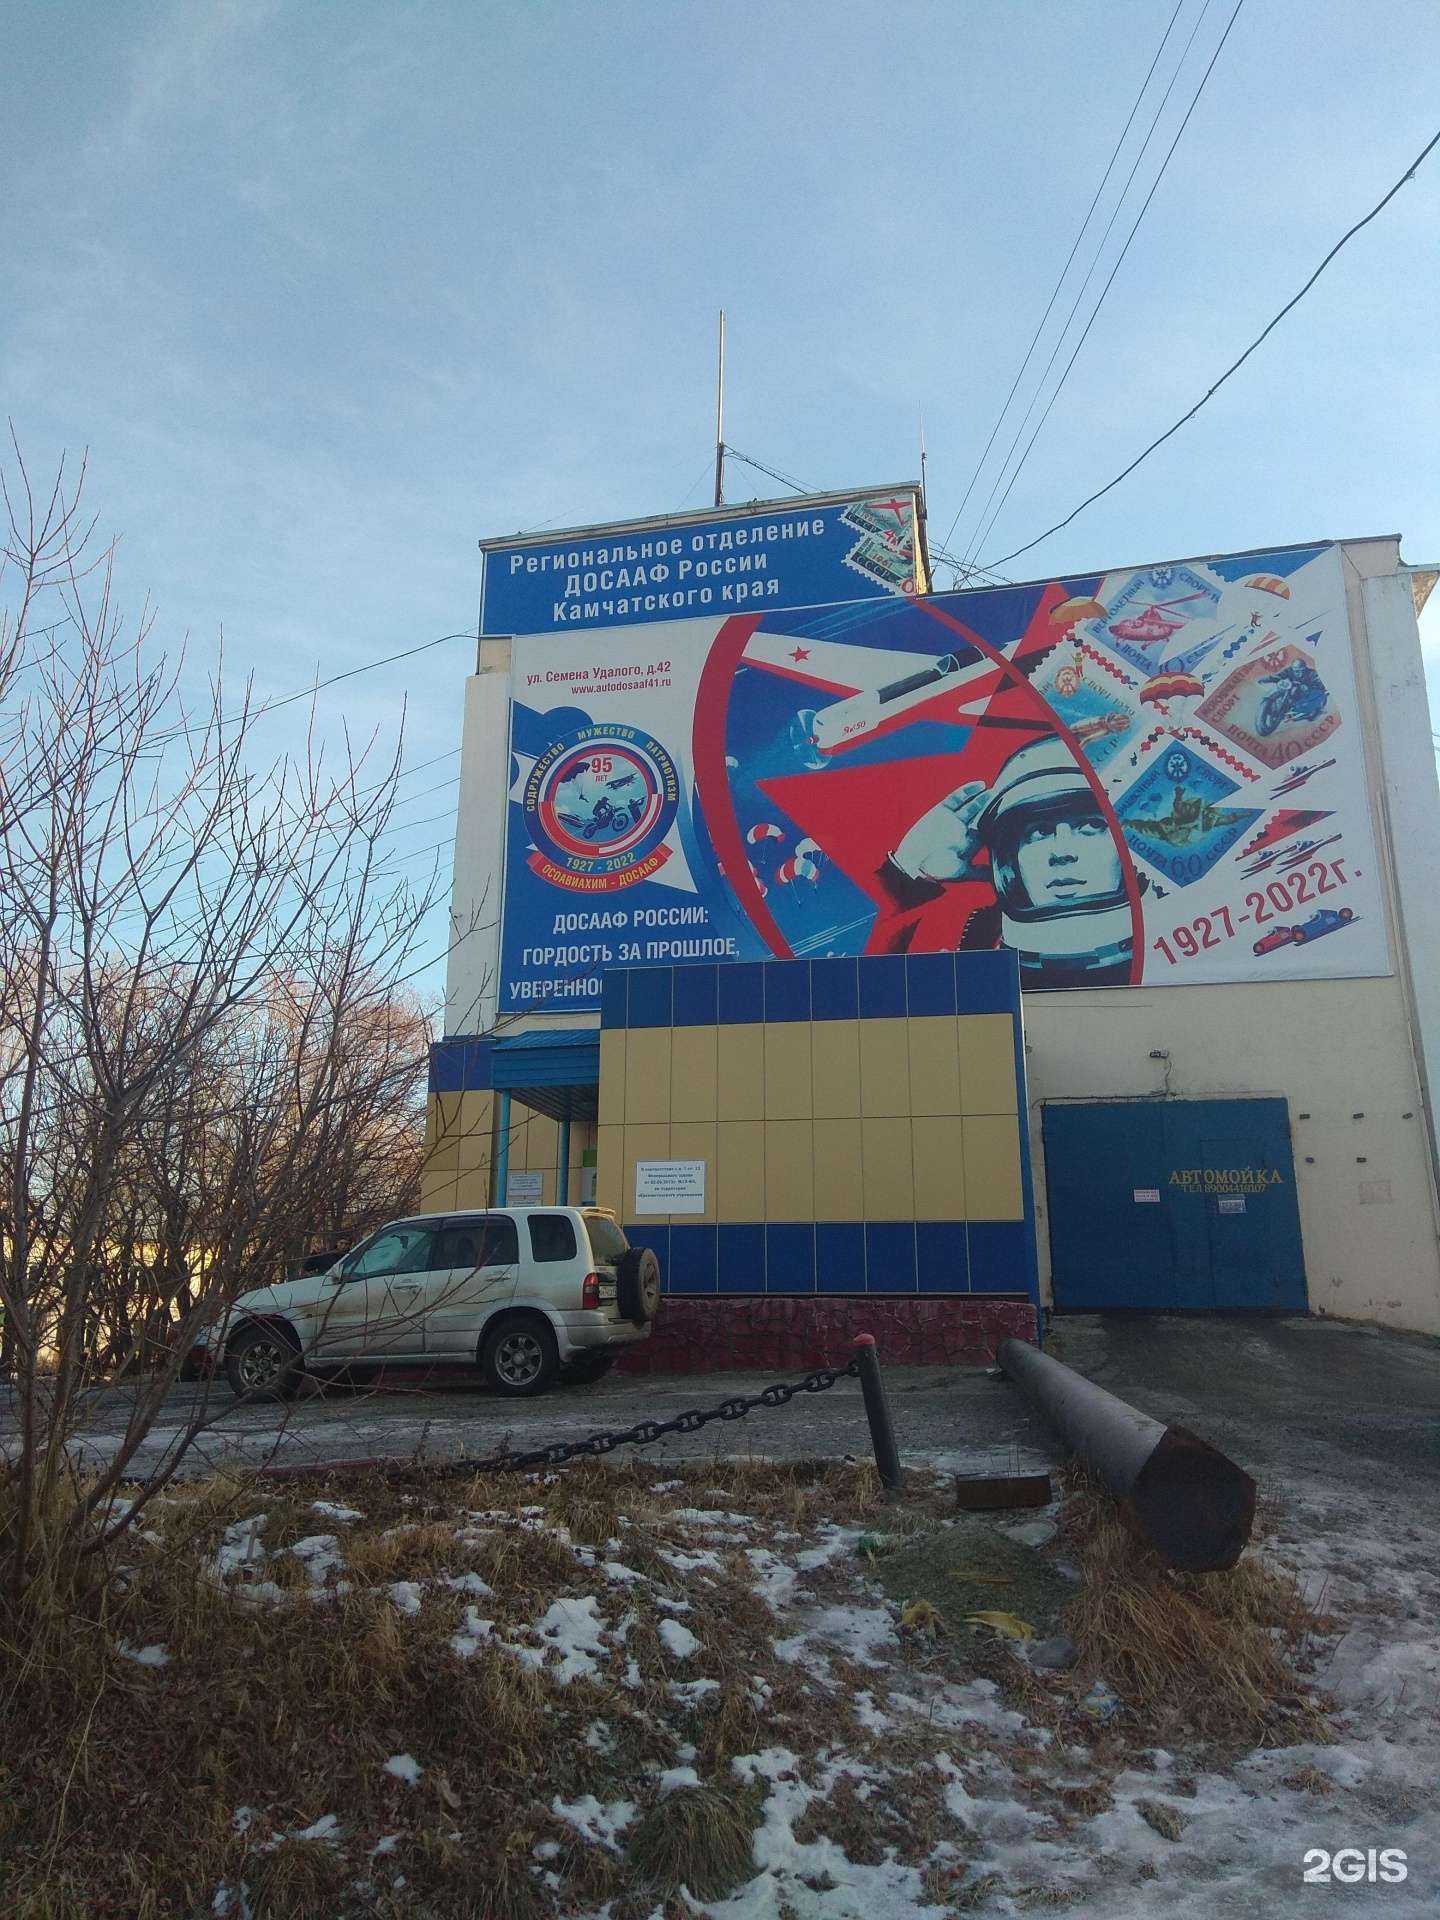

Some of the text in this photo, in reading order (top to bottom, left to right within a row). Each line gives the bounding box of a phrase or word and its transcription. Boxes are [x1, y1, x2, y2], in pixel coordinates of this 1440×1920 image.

[510, 539, 682, 575] Региональное
[691, 518, 825, 551] отделение
[564, 553, 768, 598] ДОСААФ России
[553, 580, 780, 622] Камчатского края
[527, 661, 671, 686] ул. Семена Удалого, д.42
[571, 678, 672, 695] www.autodosaaf41.ru
[577, 726, 635, 741] МУЖЕСТВО
[526, 742, 566, 812] СОДРУЖЕСТВО
[591, 757, 612, 773] 95
[646, 740, 676, 802] ПАТРИОТИЗМ
[542, 864, 607, 889] ОСОАВИАХИМ
[619, 857, 659, 886] ДОСААФ
[566, 857, 594, 872] 1927
[606, 852, 637, 871] 2022
[553, 906, 709, 934] ДОСААФ РОССИИ:
[1153, 858, 1363, 965] 1927-2022г.
[523, 938, 740, 967] ГОРДОСТЬ ЗА ПРОШЛОЕ,
[509, 978, 602, 1000] УВЕРЕННО
[1168, 1166, 1284, 1184] АВТОМОЙКА
